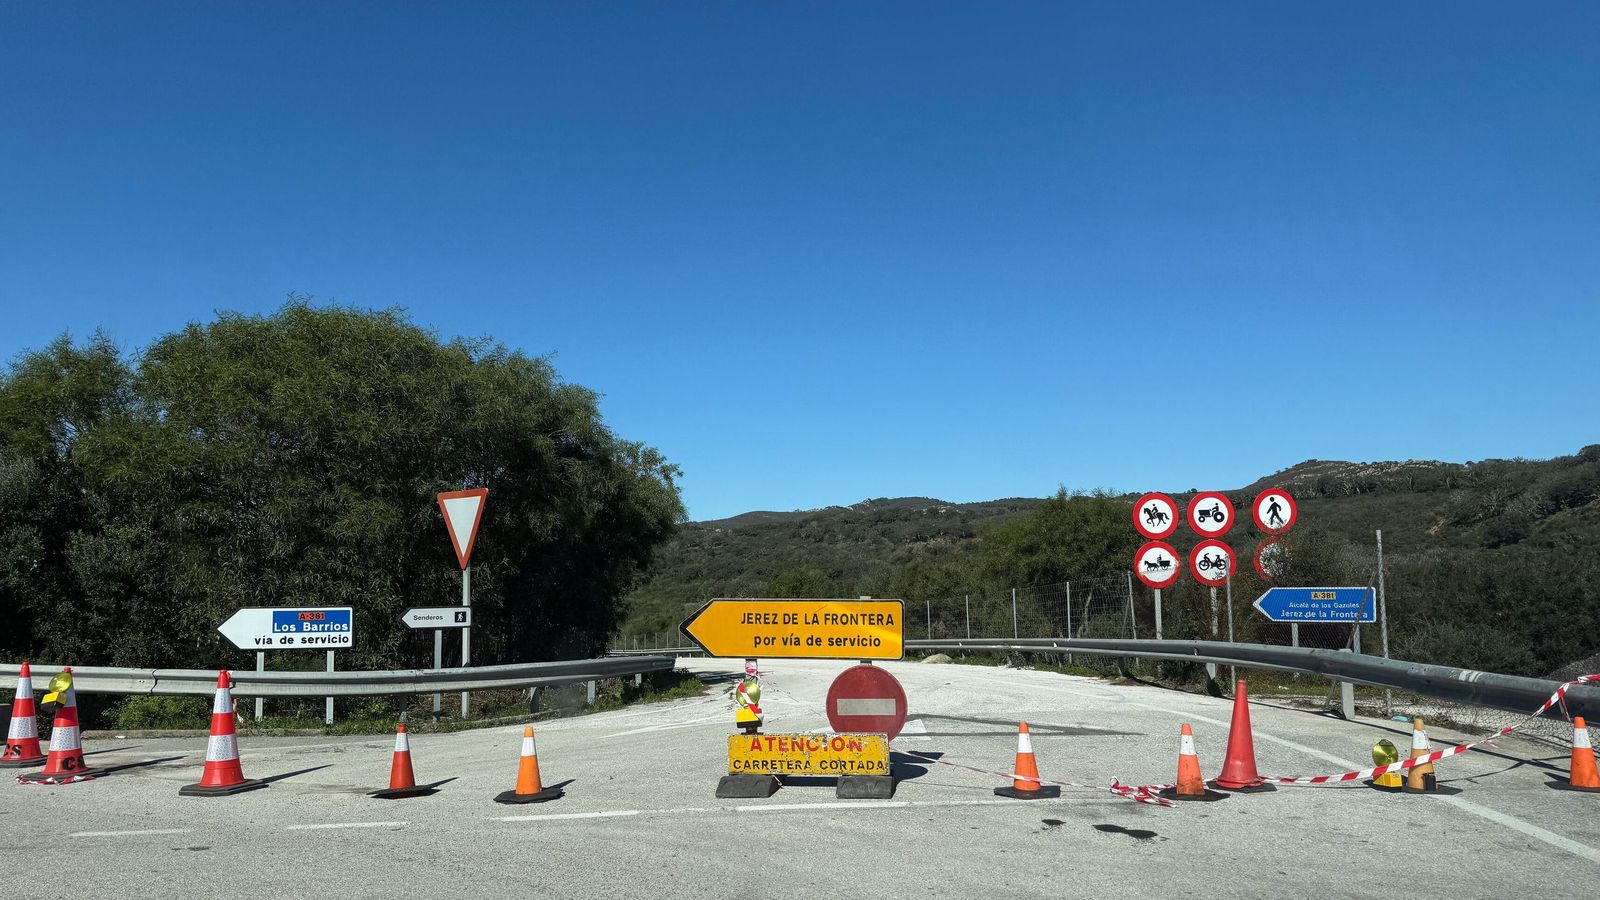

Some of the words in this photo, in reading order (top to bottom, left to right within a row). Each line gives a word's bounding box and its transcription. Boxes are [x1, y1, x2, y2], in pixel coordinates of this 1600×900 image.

[299, 612, 325, 620] A-381
[741, 612, 778, 625] JEREZ
[783, 612, 799, 625] DE
[804, 612, 820, 625] LA
[824, 612, 894, 626] FRONTERA
[1305, 610, 1316, 618] de
[1330, 610, 1368, 618] Frontea
[274, 622, 296, 632] Los
[302, 621, 349, 632] Barrios
[254, 635, 273, 646] vía
[280, 635, 294, 646] de
[300, 634, 349, 644] servicio
[754, 635, 776, 648] por
[782, 632, 800, 647] vía
[806, 634, 822, 647] de
[828, 634, 881, 647] servicio
[733, 760, 812, 770] CARRETERA
[819, 760, 885, 770] CORTADA
